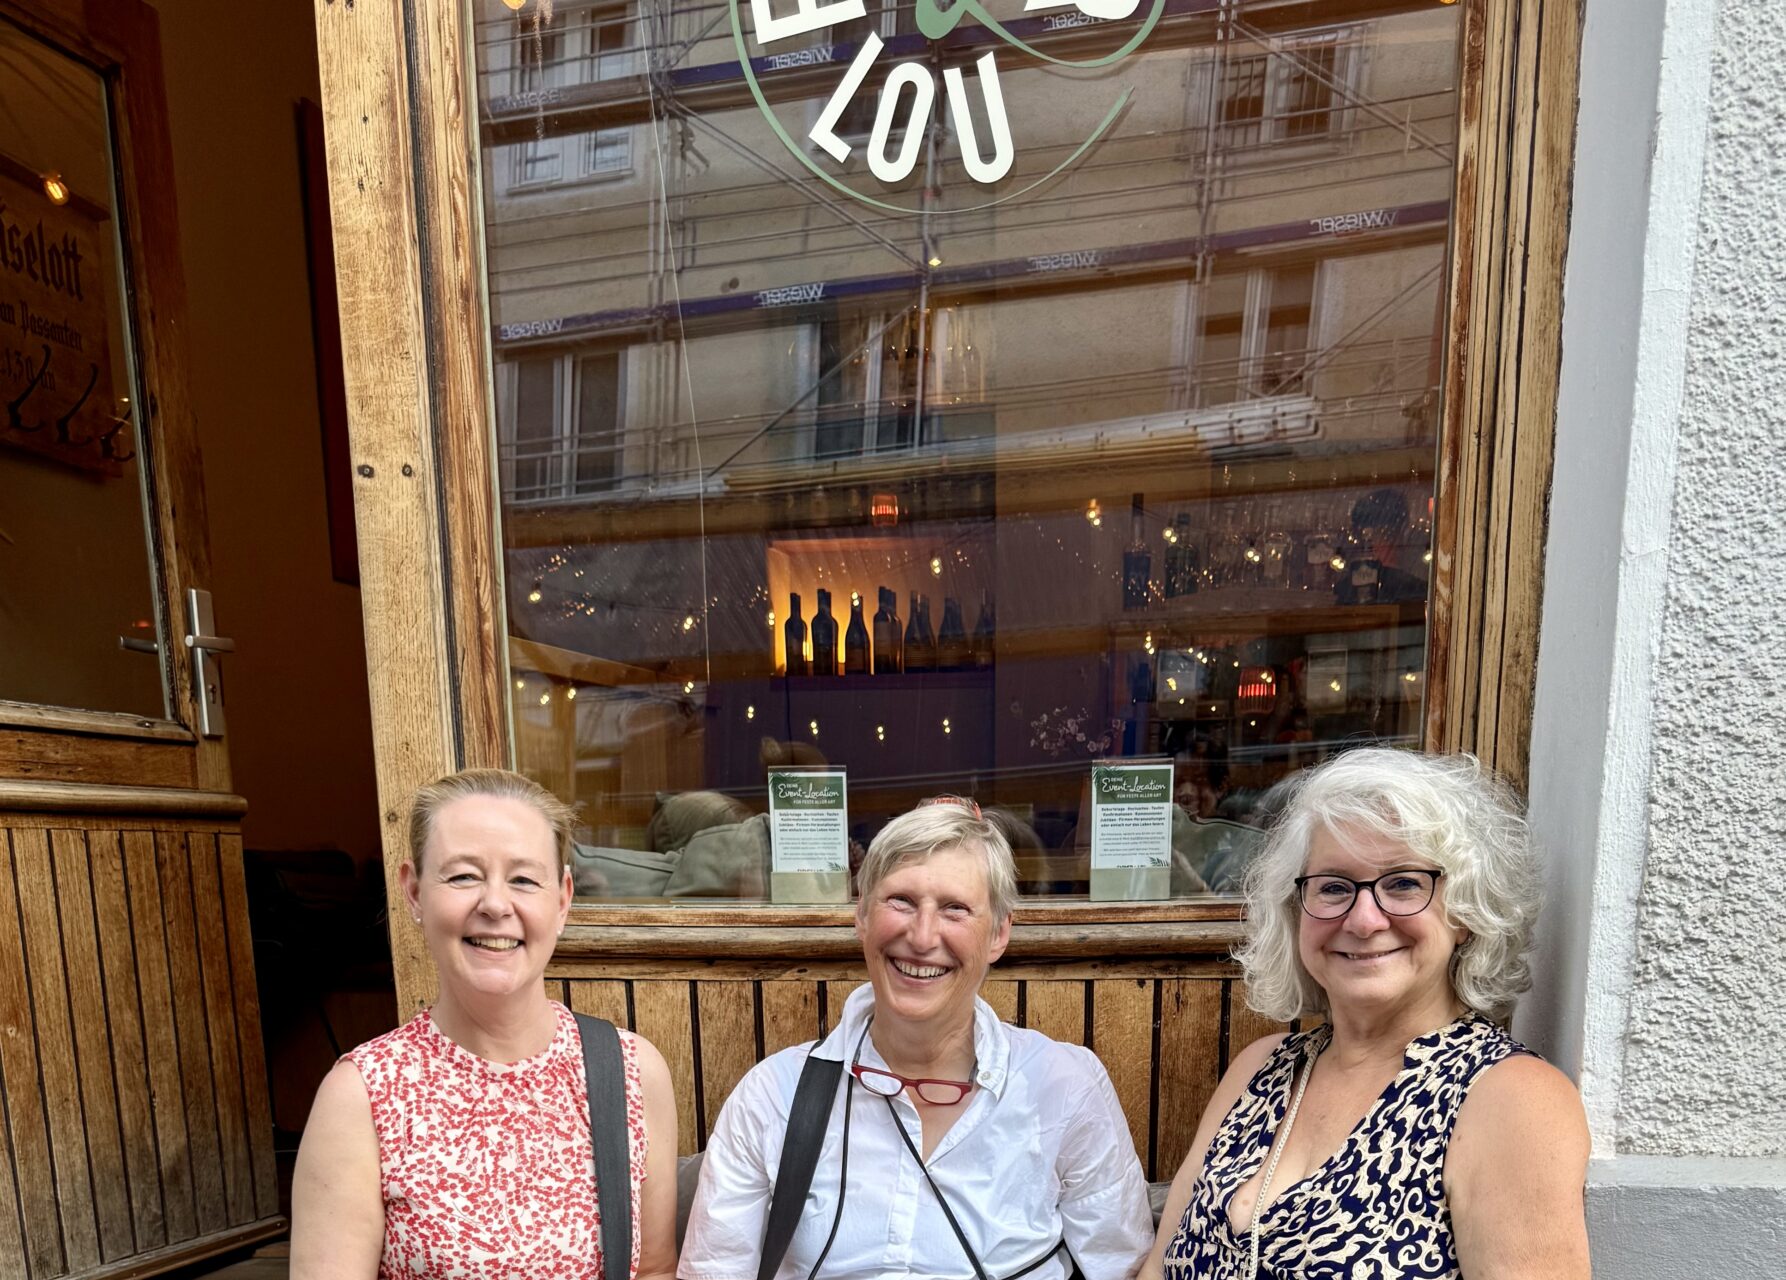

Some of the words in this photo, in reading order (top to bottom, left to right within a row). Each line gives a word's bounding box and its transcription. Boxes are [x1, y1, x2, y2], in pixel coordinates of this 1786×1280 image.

[808, 31, 1014, 183] LOU
[778, 782, 840, 798] Event-Location
[1102, 775, 1165, 792] Event-Location
